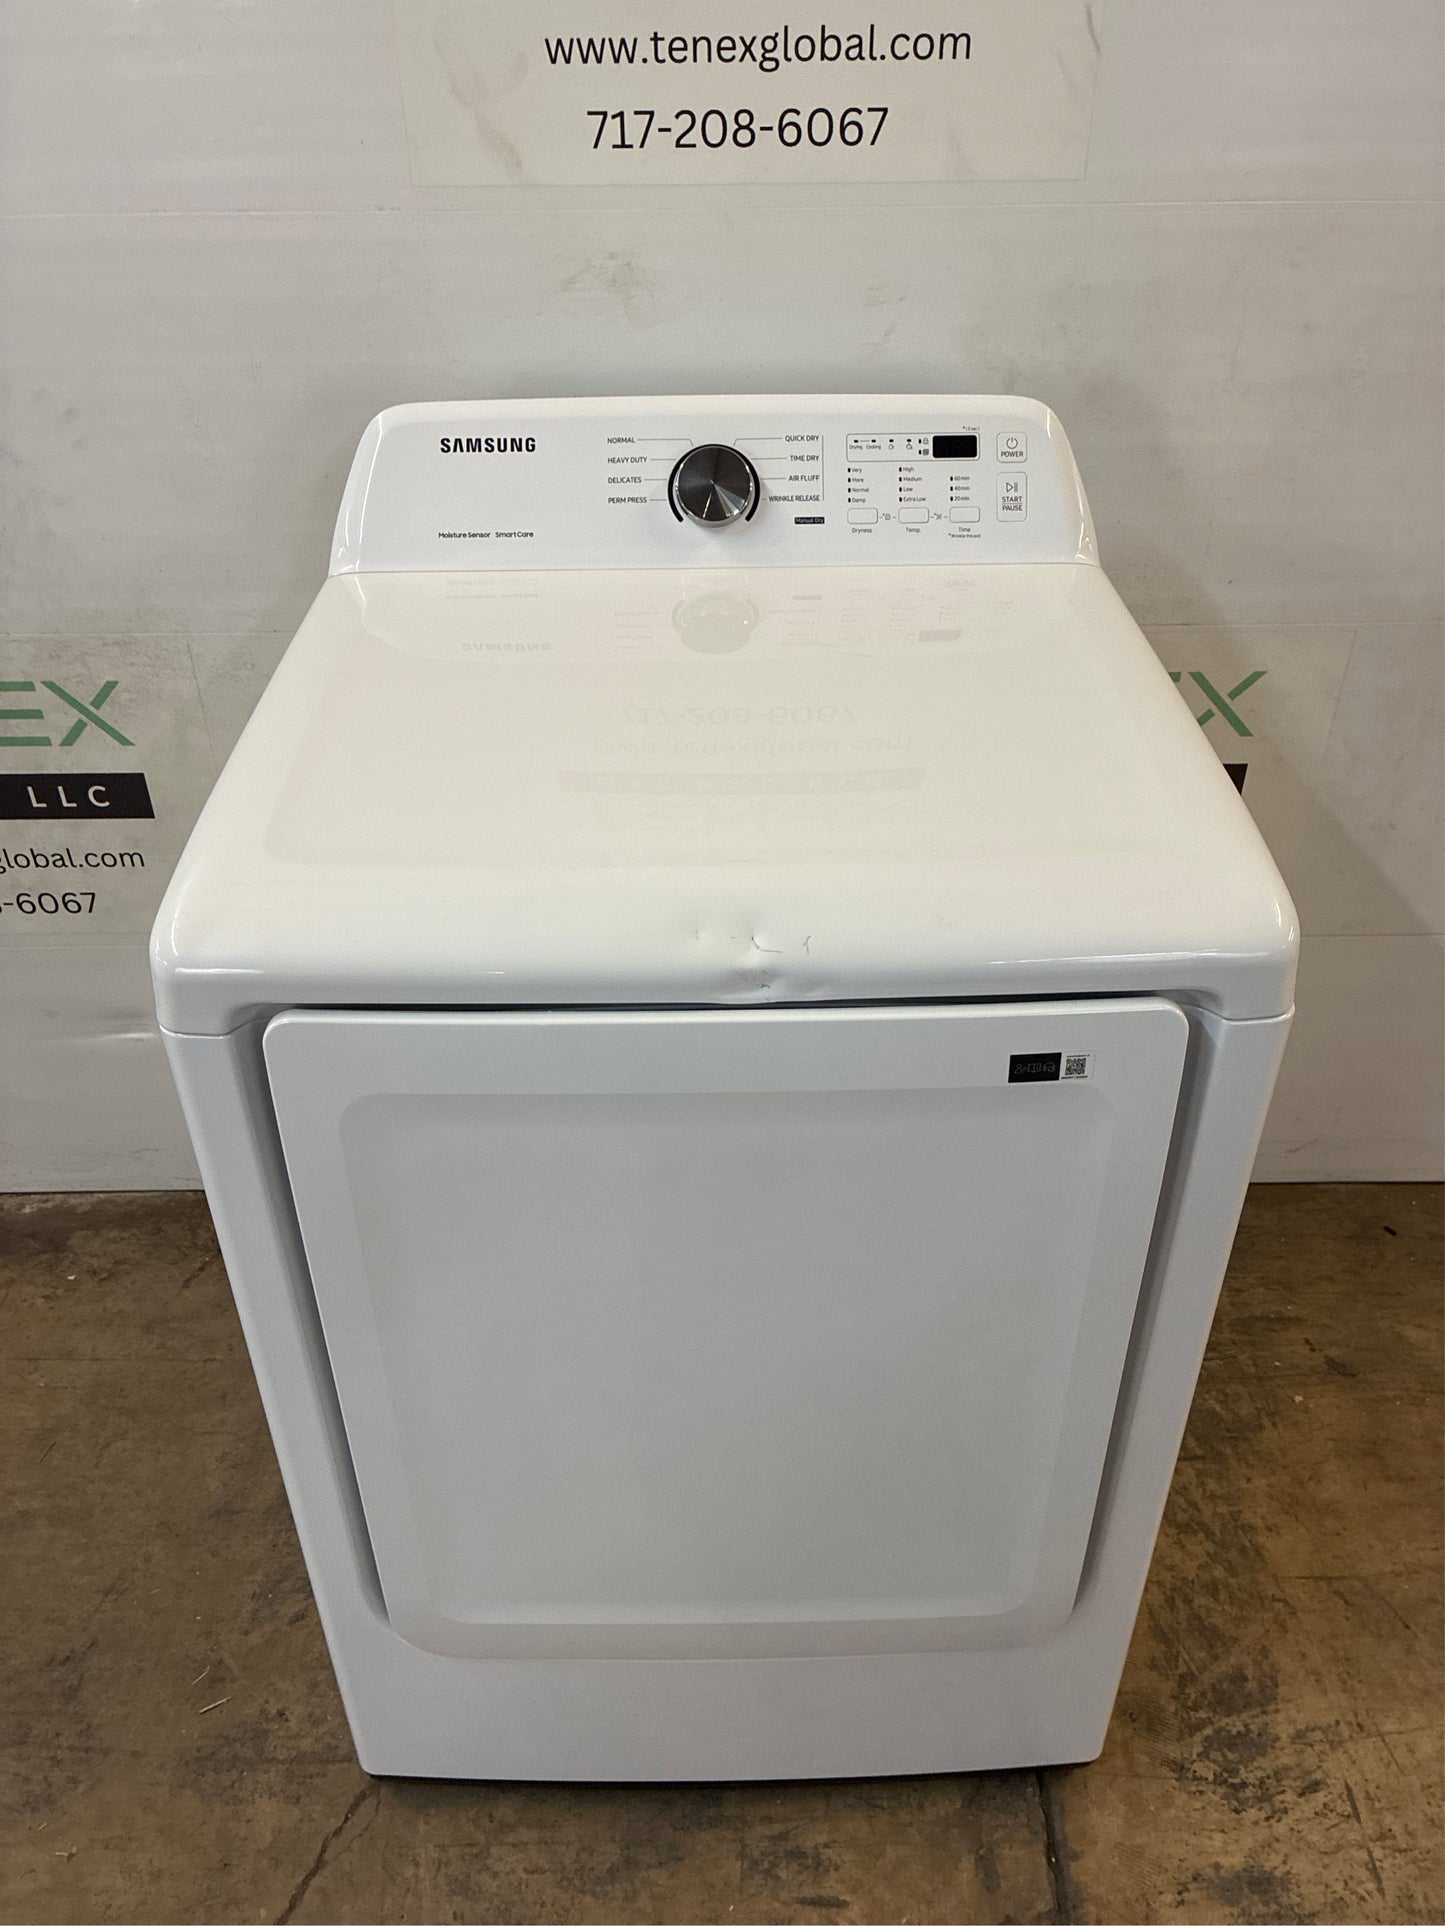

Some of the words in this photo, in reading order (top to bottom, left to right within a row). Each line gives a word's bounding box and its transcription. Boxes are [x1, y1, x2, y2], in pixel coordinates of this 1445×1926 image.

[544, 25, 973, 73] www.tenexglobal.com
[586, 107, 889, 150] 717-208-6067
[440, 437, 536, 453] SAMSUNG
[1001, 495, 1022, 503] START
[27, 785, 111, 808] LLC
[0, 892, 96, 914] -6067
